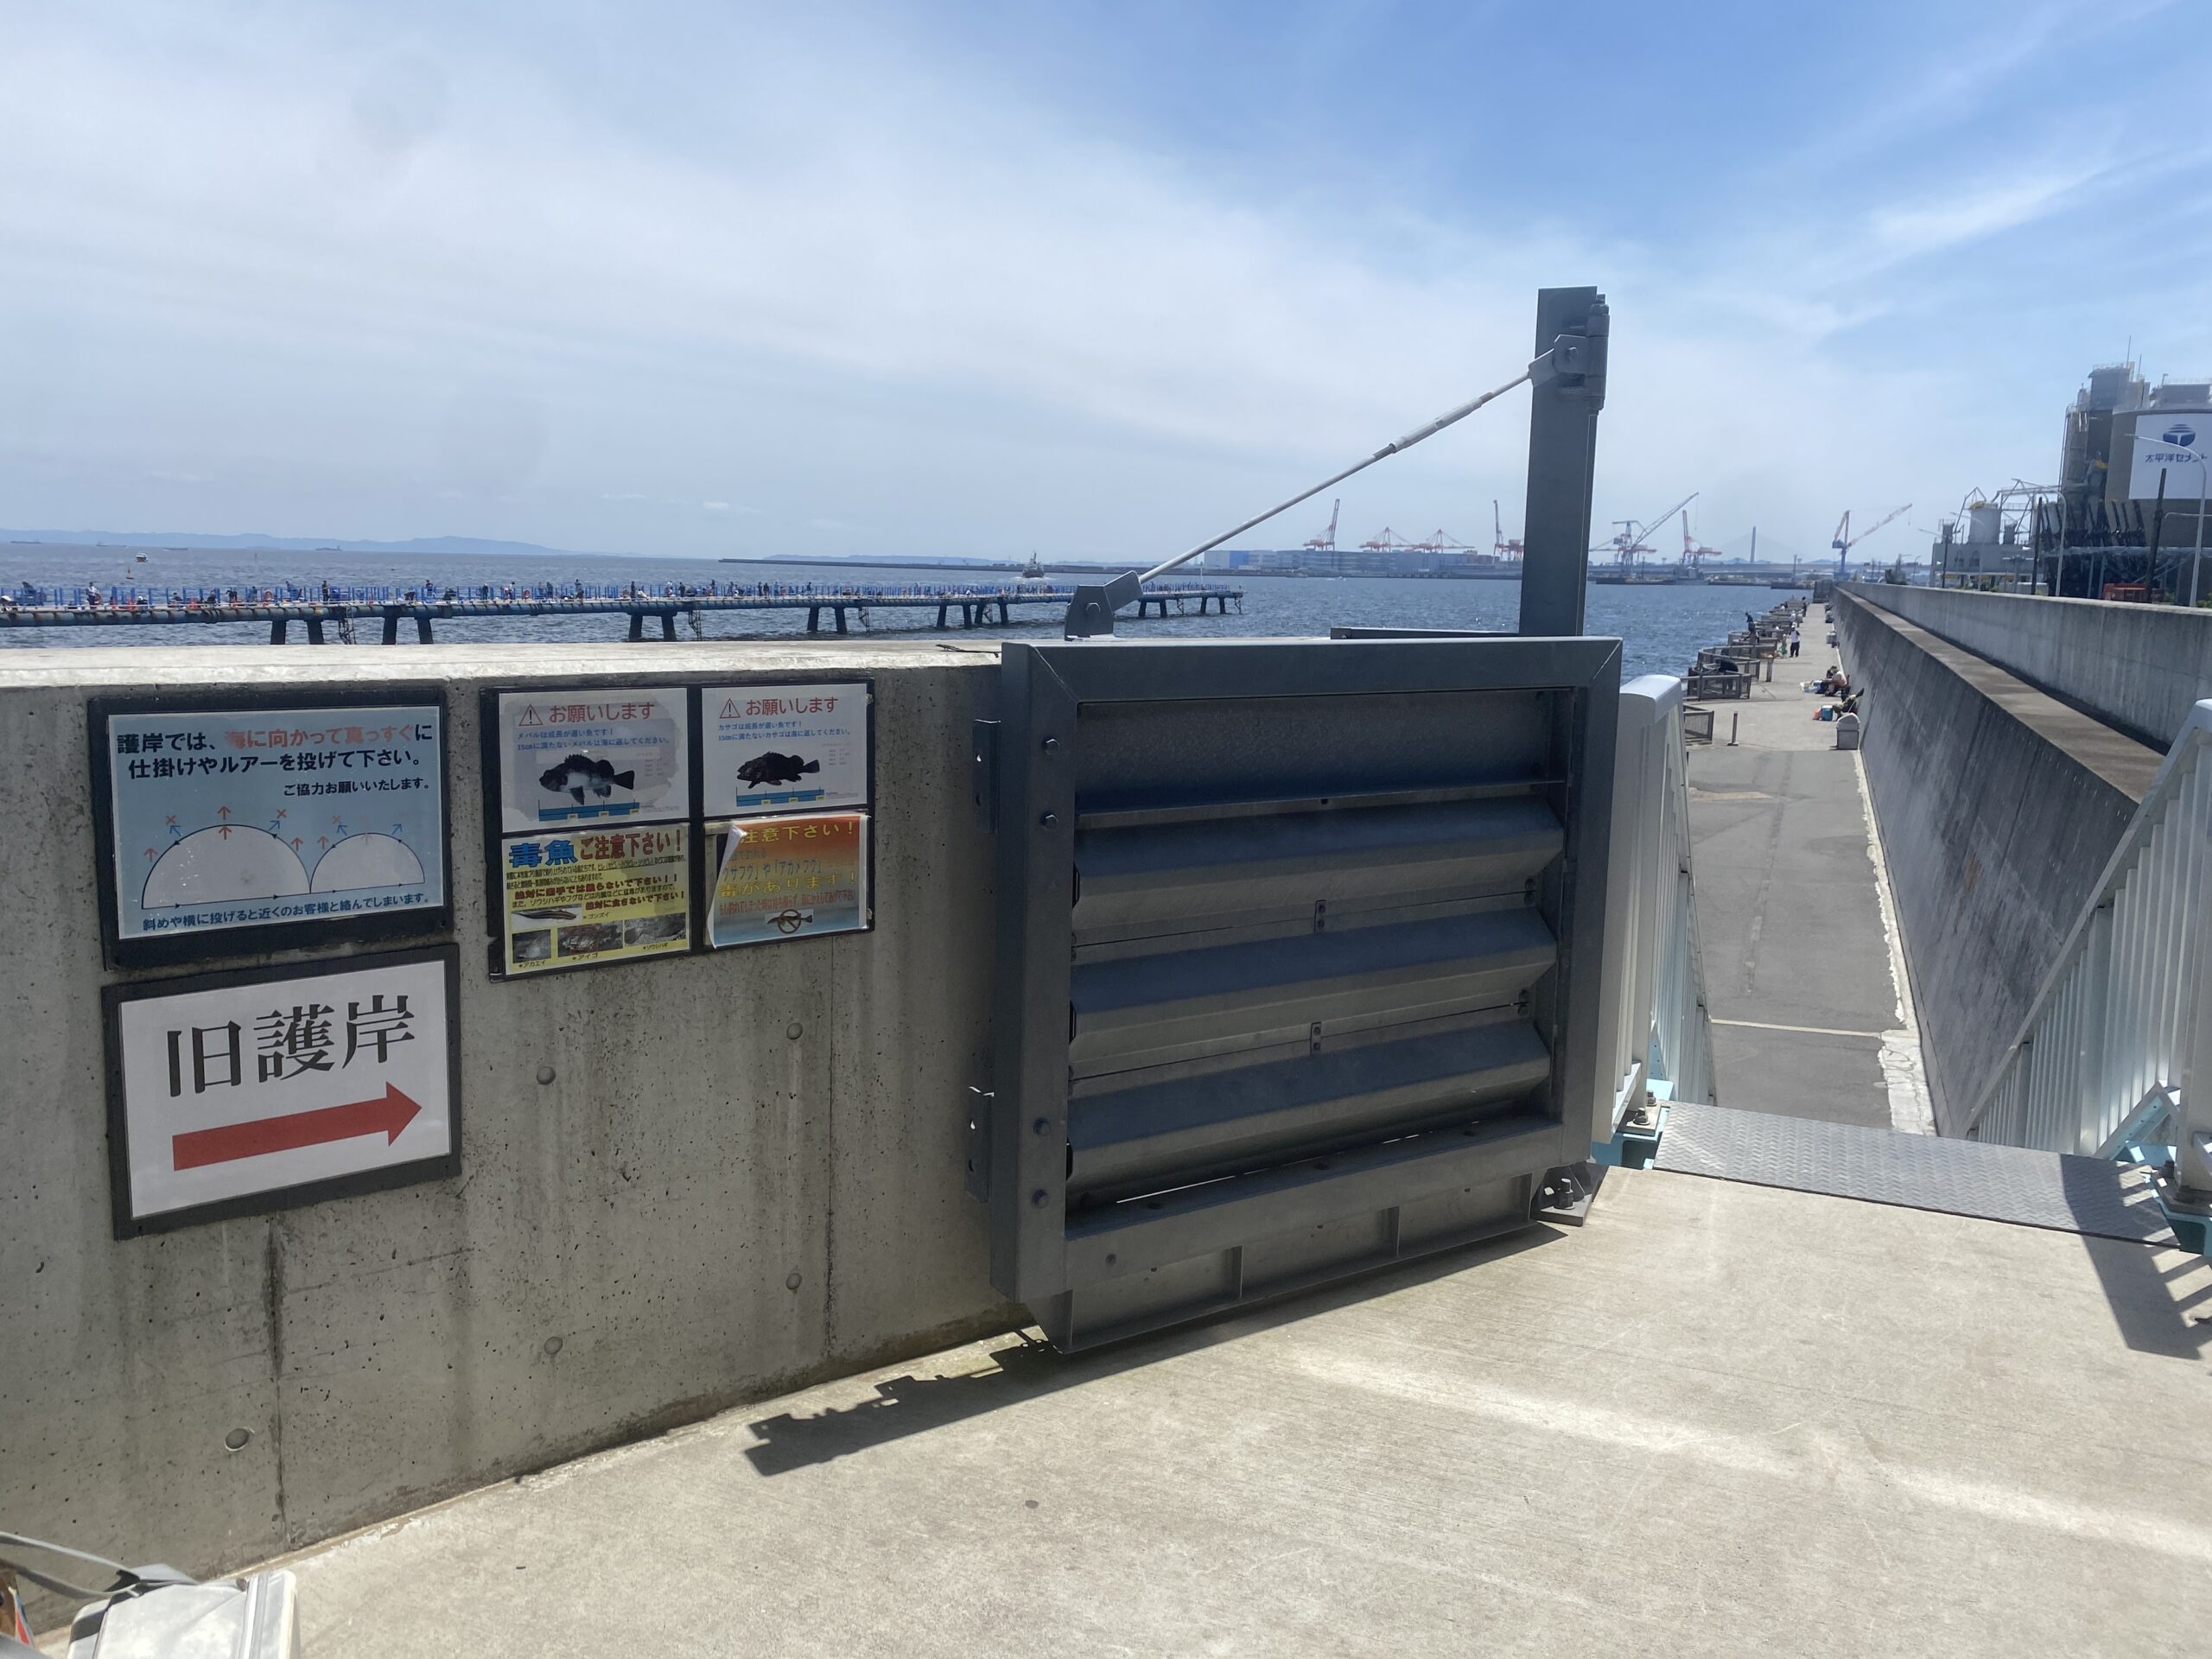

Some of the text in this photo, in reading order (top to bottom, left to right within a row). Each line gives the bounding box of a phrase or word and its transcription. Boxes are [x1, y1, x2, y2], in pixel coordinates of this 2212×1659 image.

[550, 702, 655, 723] お願いします
[746, 696, 839, 716] お願いします
[128, 749, 421, 779] 仕掛けやルアーを投げて下さい。
[283, 779, 430, 797] ご協力お願いいたします。
[509, 839, 578, 868] 毒魚
[580, 830, 681, 861] ご注意下さい！
[719, 872, 857, 899] 毒があります！
[143, 893, 429, 931] 斜めや横に投げると近くのお客様と絡んでしまいます。
[168, 995, 416, 1097] 旧護岸
